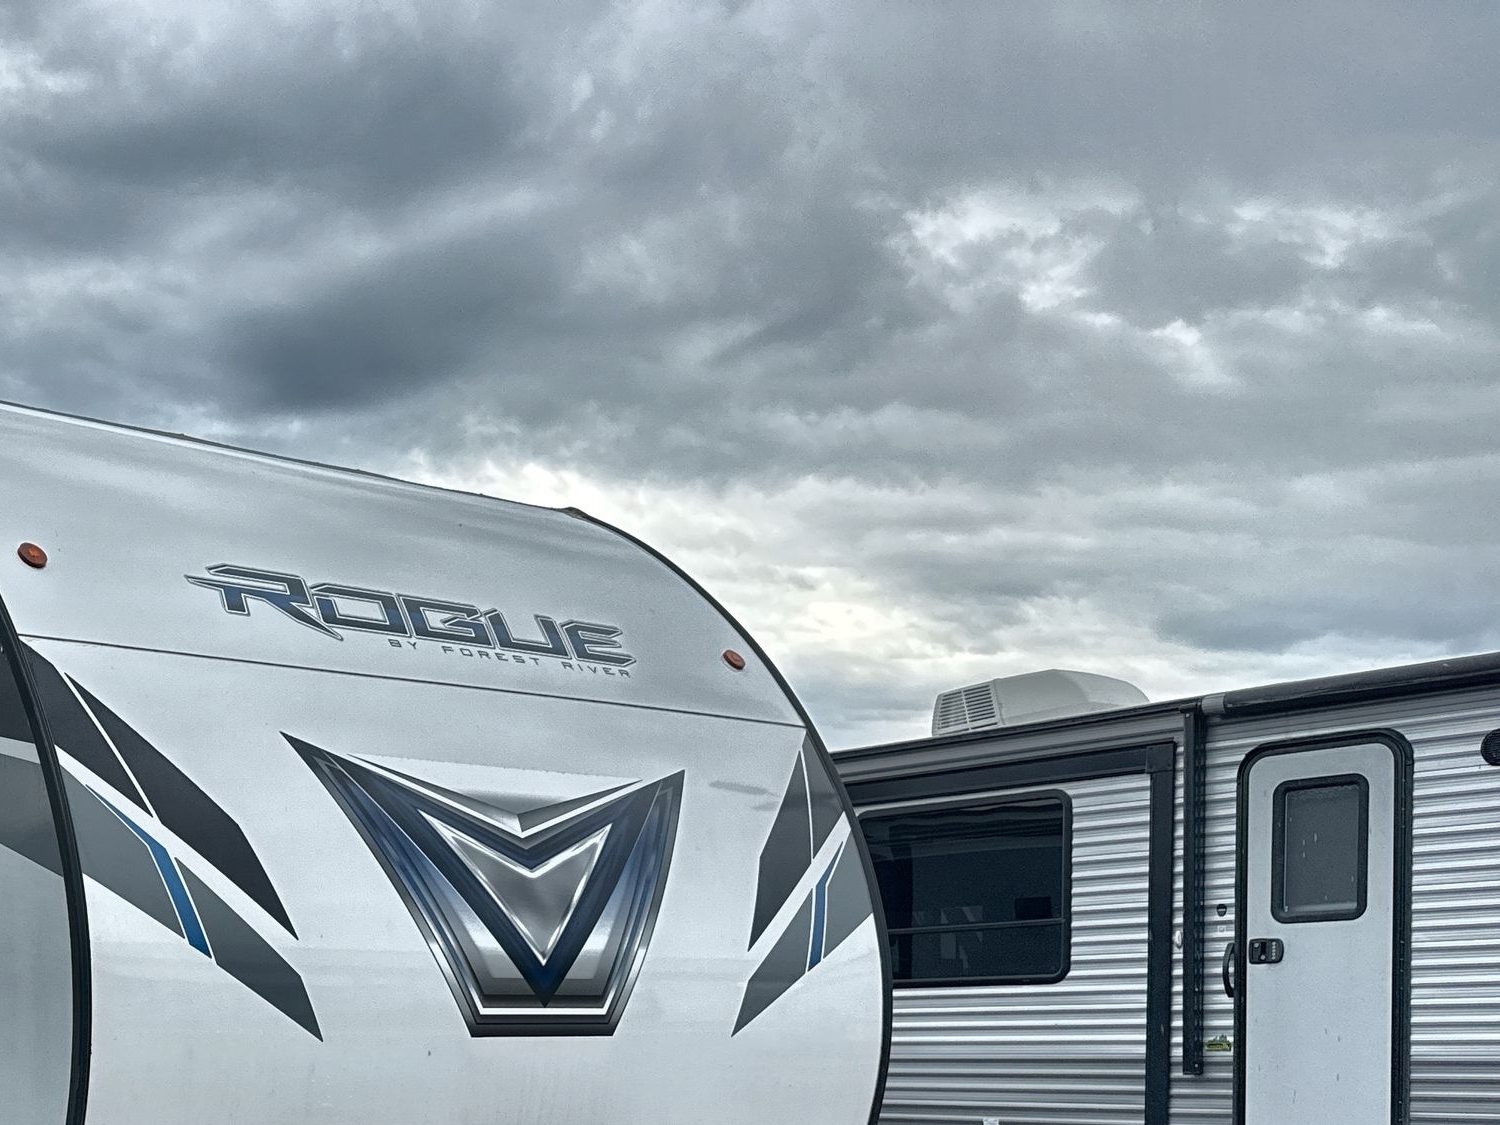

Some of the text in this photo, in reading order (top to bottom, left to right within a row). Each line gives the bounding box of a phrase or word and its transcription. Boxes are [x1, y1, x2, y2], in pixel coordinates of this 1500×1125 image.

[185, 563, 636, 669] ROGUE
[388, 638, 632, 679] BY FOREST RIVER
